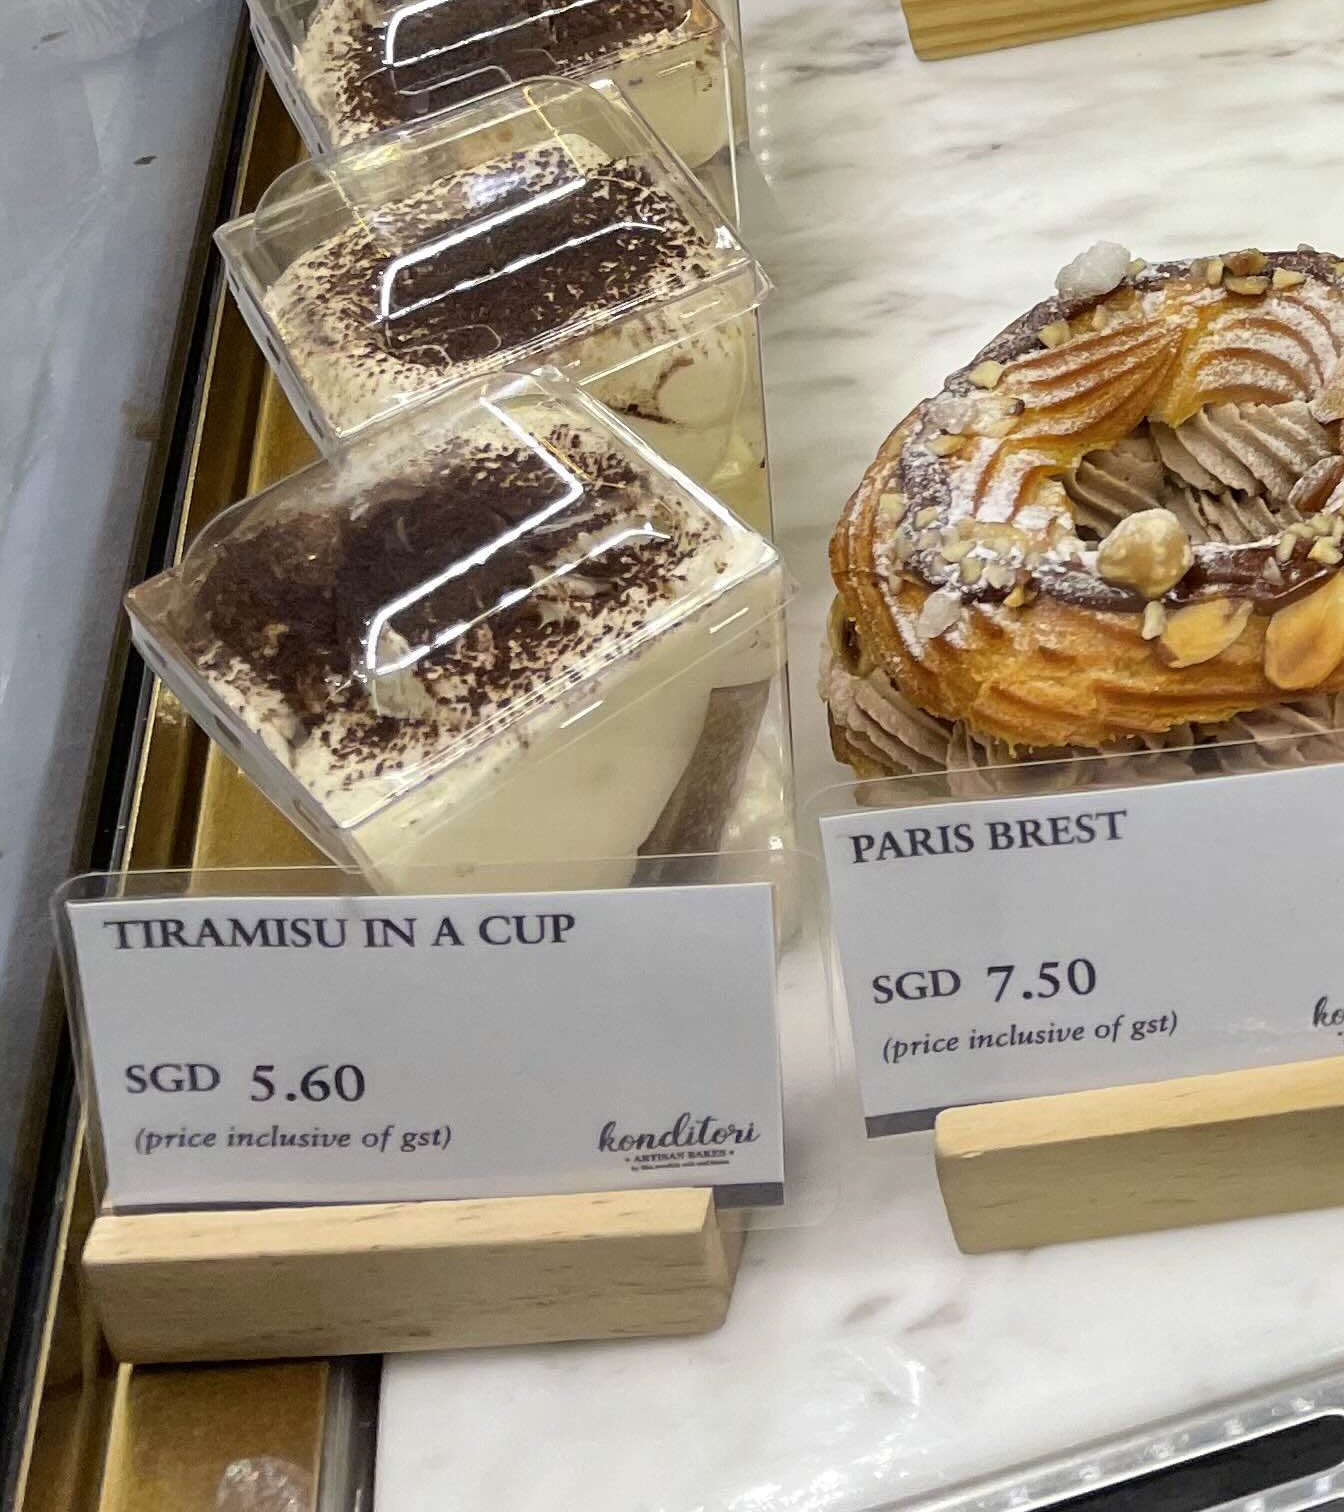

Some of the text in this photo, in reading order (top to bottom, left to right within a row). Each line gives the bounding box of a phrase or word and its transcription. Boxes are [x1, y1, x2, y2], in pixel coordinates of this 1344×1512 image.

[850, 809, 1128, 865] PARIS BREST
[103, 912, 576, 952] TIRAMISU IN A CUP
[871, 957, 1098, 1004] SGD 7.50
[882, 1011, 1178, 1064] (price inclusive of gst)
[124, 1063, 366, 1104] SGD 5.60
[134, 1124, 453, 1156] (price inclusive of gst)
[598, 1112, 760, 1152] konditori
